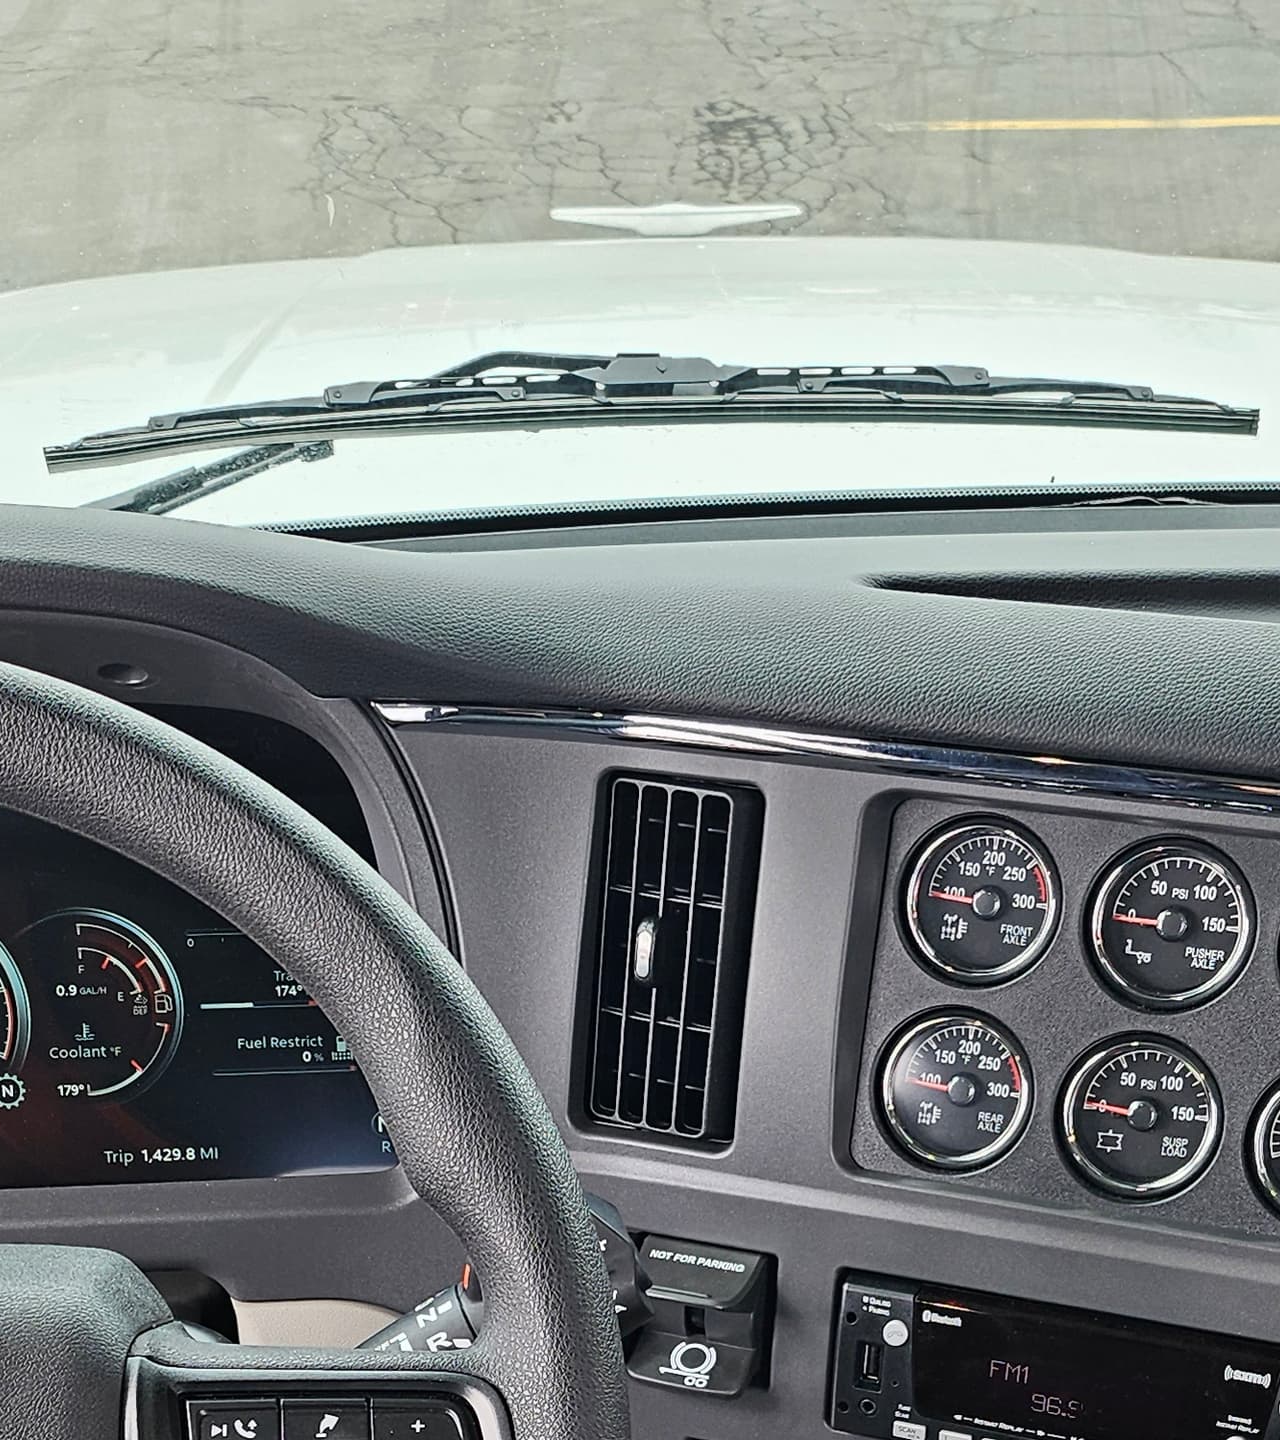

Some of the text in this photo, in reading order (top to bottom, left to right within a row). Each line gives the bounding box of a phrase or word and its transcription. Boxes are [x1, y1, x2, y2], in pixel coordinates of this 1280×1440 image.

[982, 851, 1006, 866] 200
[958, 861, 981, 877] 150
[1002, 866, 1026, 881] 250
[1150, 881, 1217, 901] 50 PSI 100
[1012, 893, 1035, 909] 300
[1000, 923, 1033, 937] FRONT
[1202, 916, 1226, 932] 150
[1002, 934, 1027, 946] AXLE
[1185, 946, 1225, 962] PUSHER
[1190, 958, 1216, 970] AXLE
[55, 985, 108, 997] 0.9 GAL/H
[117, 992, 125, 1001] E
[237, 1035, 324, 1049] Fuel Restrict
[958, 1040, 981, 1055] 200
[49, 1045, 107, 1059] Coolant
[302, 1051, 311, 1062] 0
[934, 1049, 956, 1065] 150
[978, 1055, 1001, 1071] 250
[1120, 1072, 1183, 1091] 50 PSI 100
[2, 1085, 14, 1098] N
[986, 1082, 1010, 1098] 300
[977, 1111, 1004, 1124] REAR
[1171, 1105, 1195, 1121] 150
[977, 1121, 1001, 1133] AXLE
[1162, 1136, 1189, 1148] SUSP
[104, 1147, 219, 1165] Trip 1,429.8 MI
[1160, 1146, 1187, 1158] LOAD
[650, 1249, 745, 1273] NOT FOR PARKING
[416, 1306, 439, 1329] N
[989, 1359, 1029, 1384] FM1
